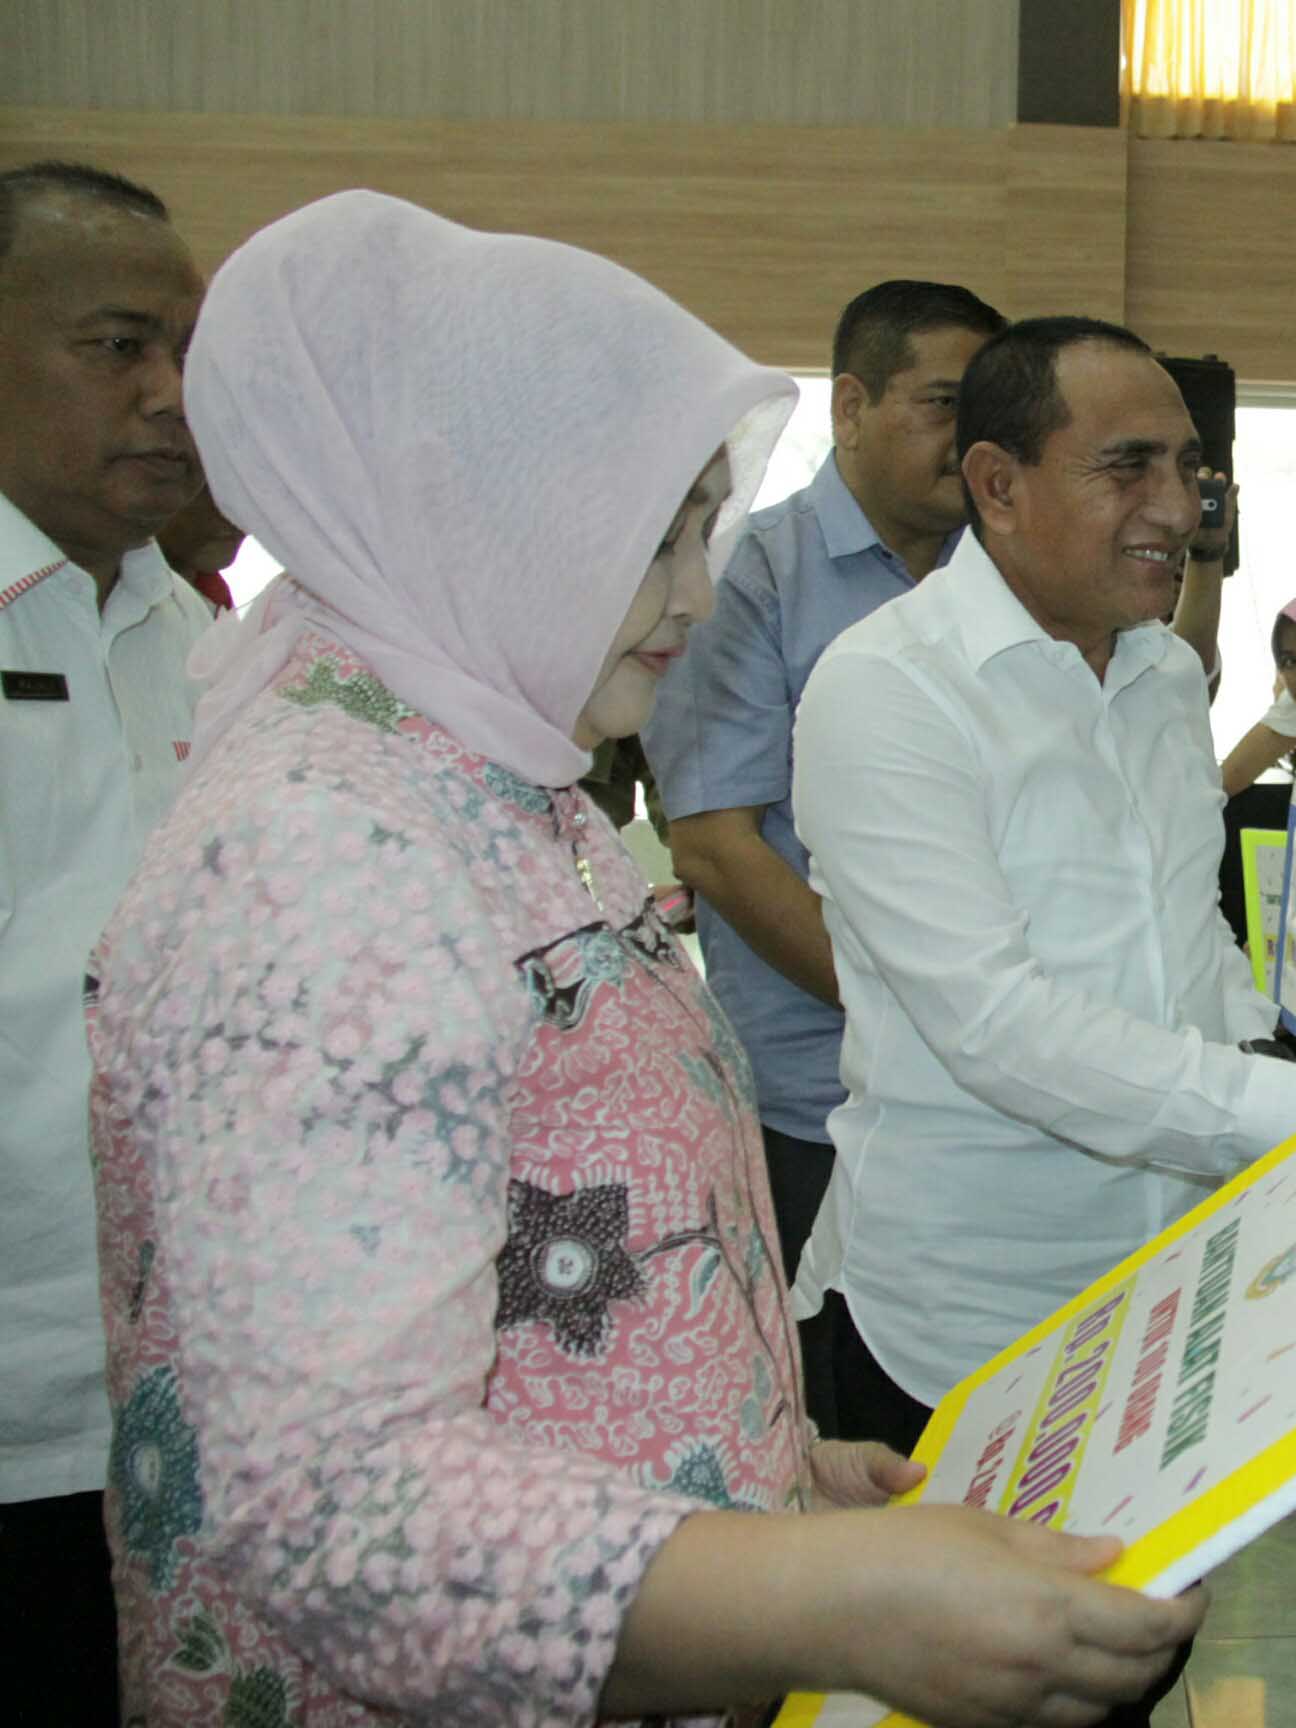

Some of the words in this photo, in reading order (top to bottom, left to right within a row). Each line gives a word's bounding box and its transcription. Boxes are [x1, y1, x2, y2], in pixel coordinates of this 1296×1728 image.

[1190, 1216, 1242, 1328] BANTUAN
[1177, 1311, 1226, 1386] ALAT
[1159, 1370, 1216, 1471] FISIK
